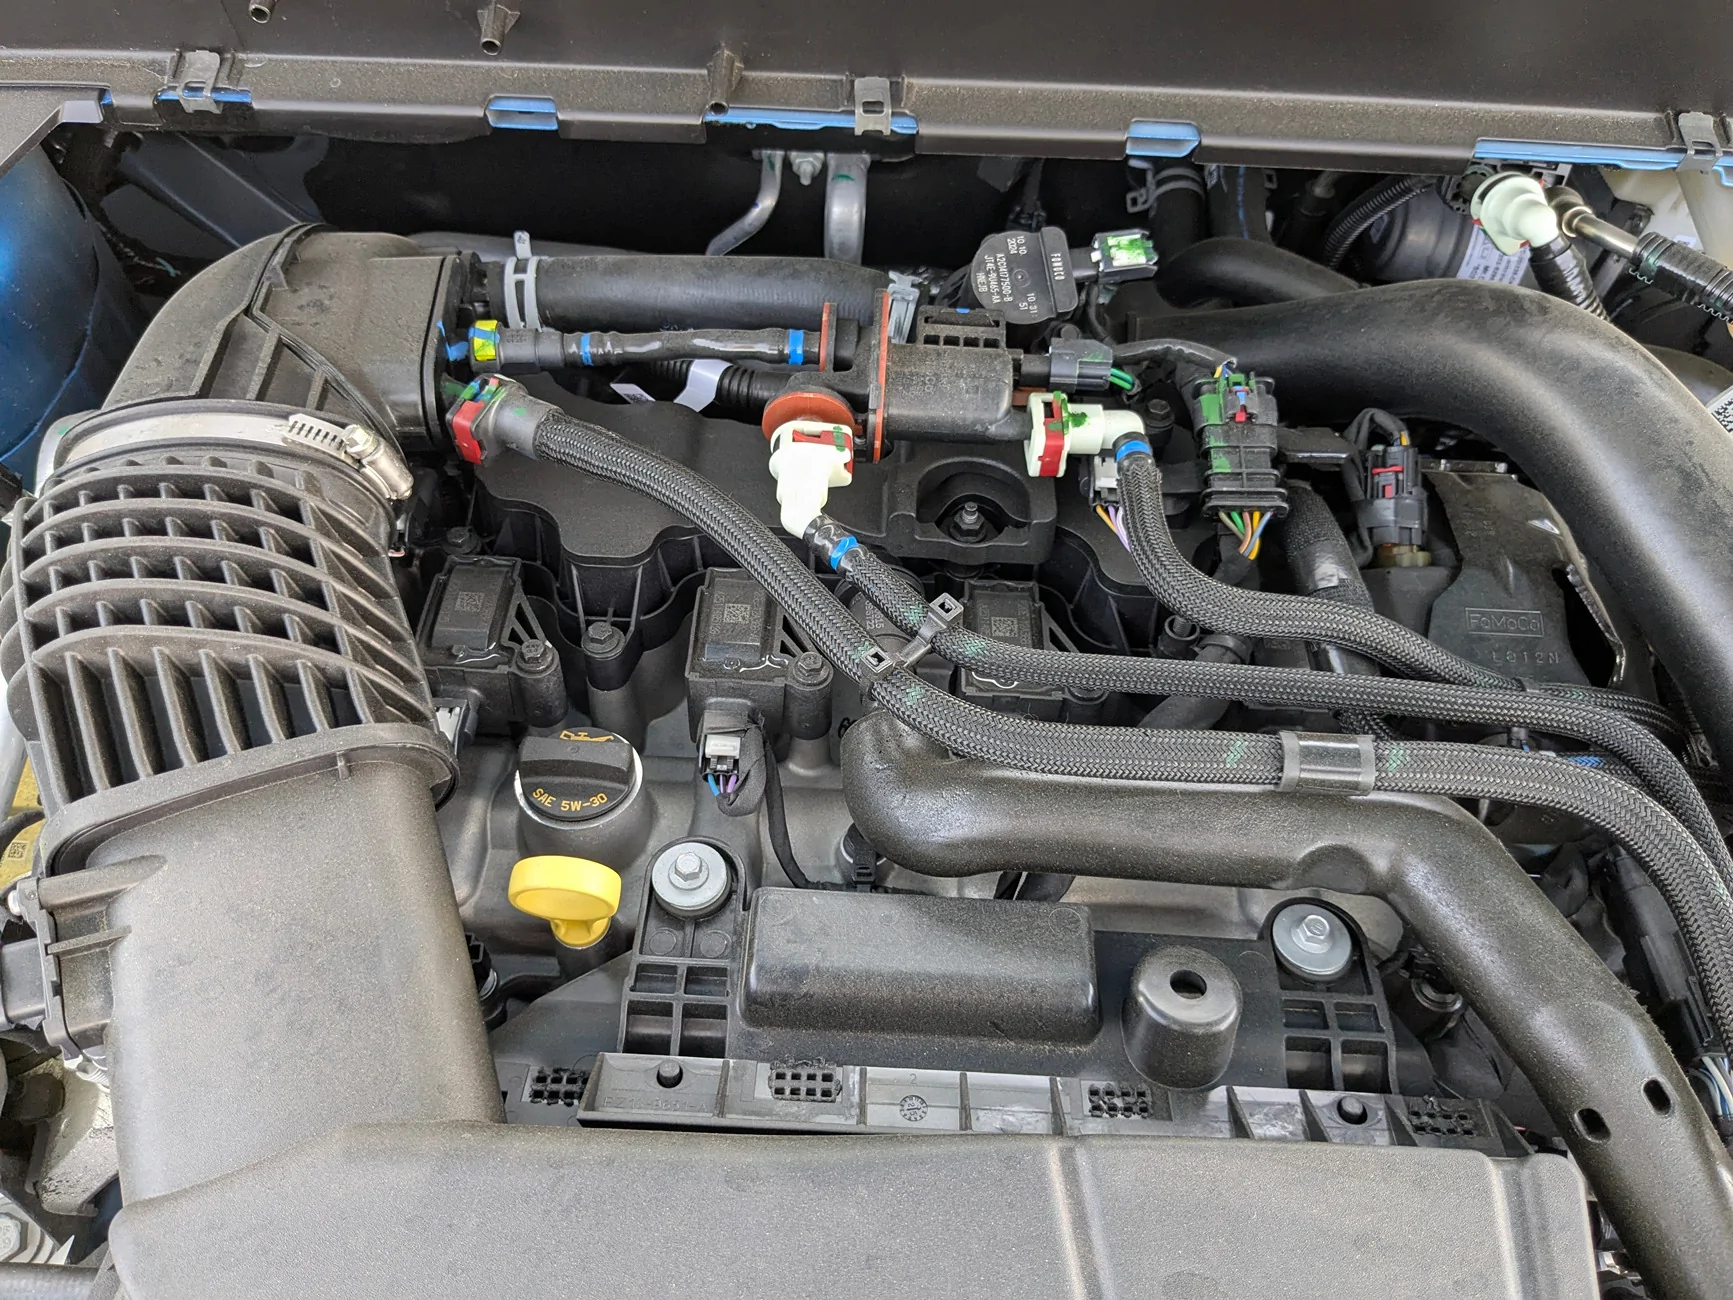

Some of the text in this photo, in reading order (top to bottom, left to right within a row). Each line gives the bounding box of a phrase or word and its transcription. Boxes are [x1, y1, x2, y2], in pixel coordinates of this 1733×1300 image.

[1018, 302, 1028, 310] 51
[1469, 612, 1541, 632] FoMoCo
[532, 788, 608, 811] SAE 5W-30
